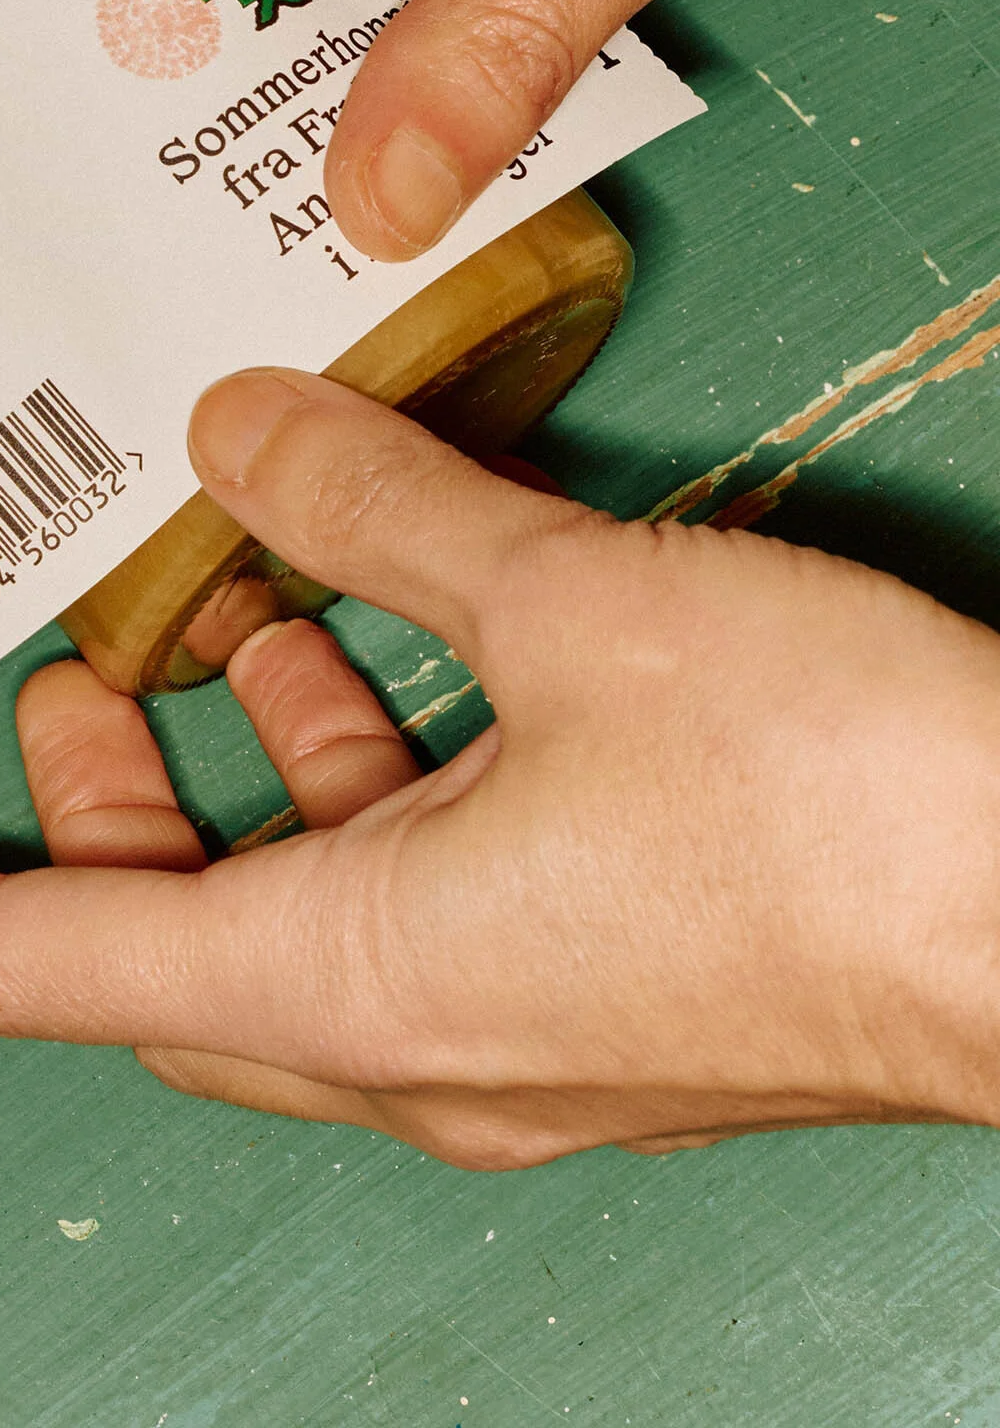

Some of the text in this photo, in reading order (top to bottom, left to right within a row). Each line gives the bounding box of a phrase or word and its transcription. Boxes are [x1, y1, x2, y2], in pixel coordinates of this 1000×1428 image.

[221, 148, 301, 210] fra
[325, 245, 359, 280] i
[20, 469, 127, 566] 560032
